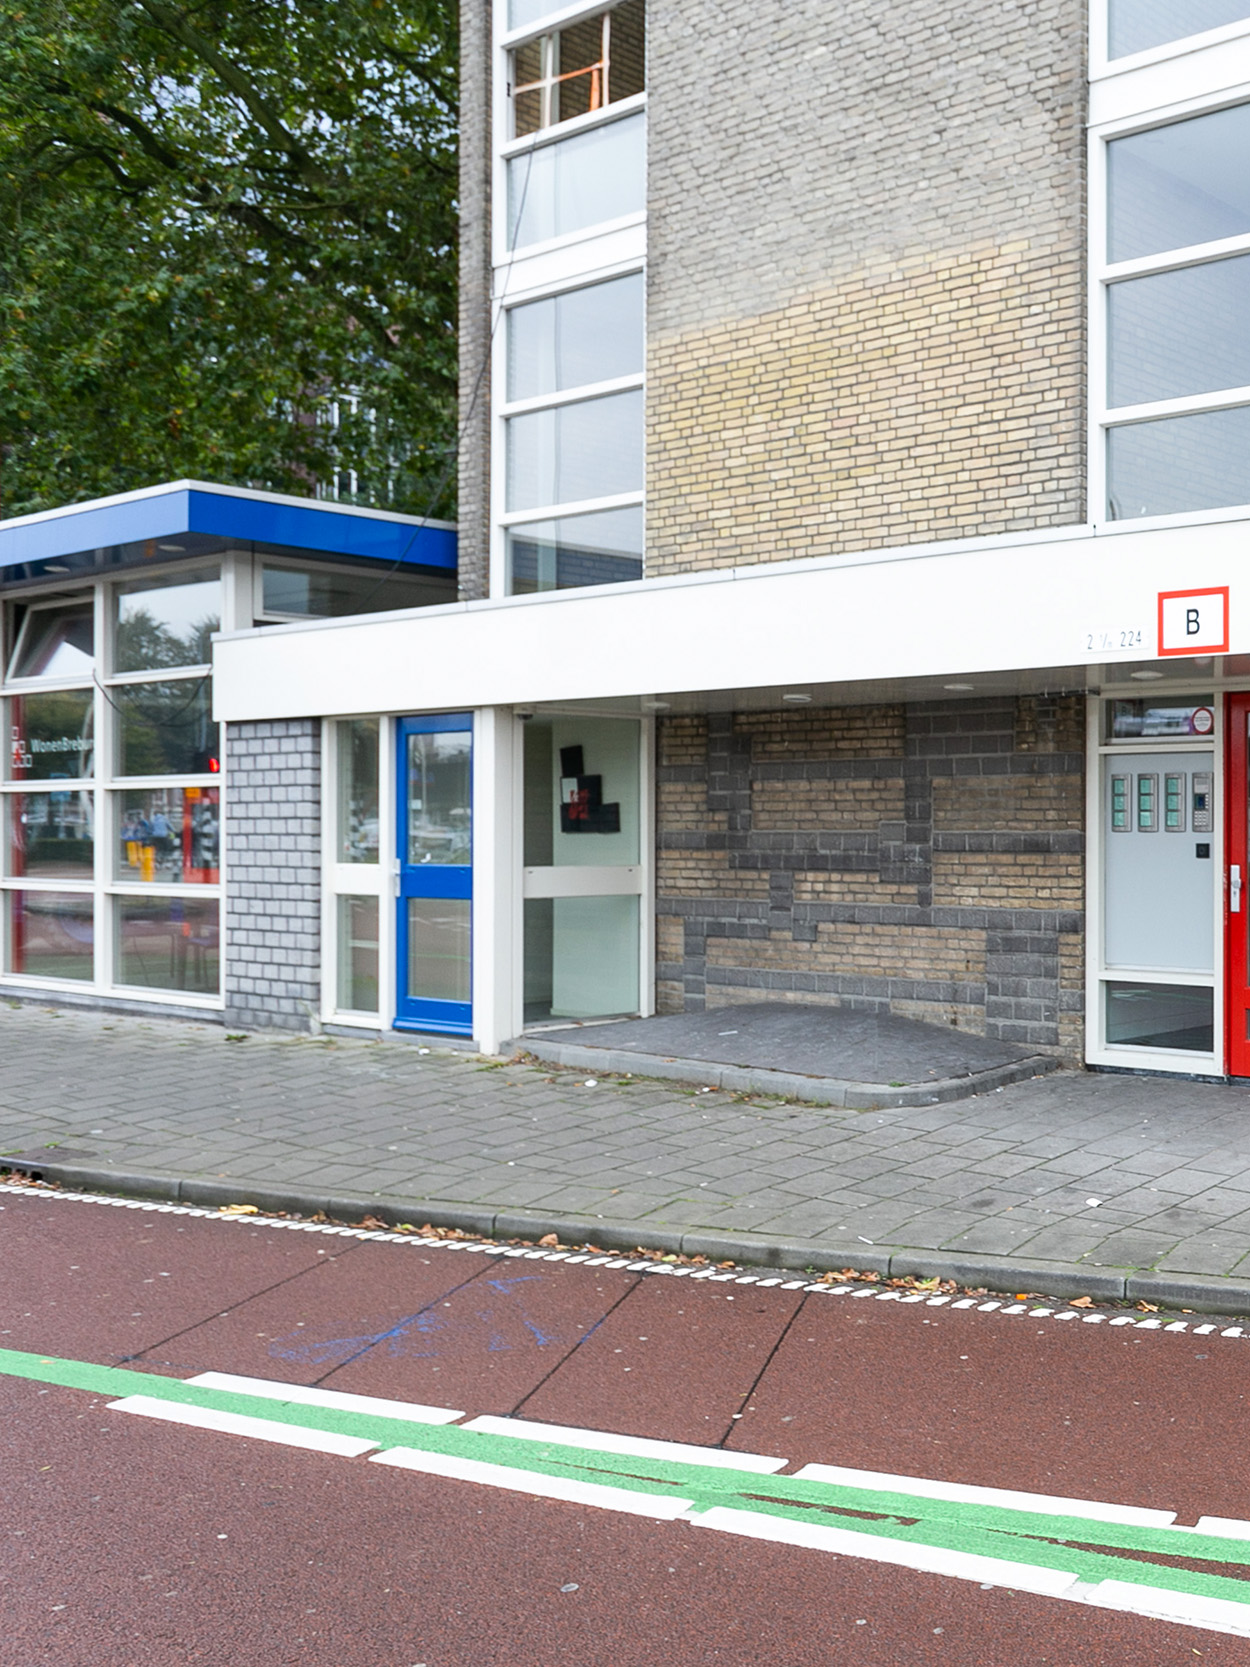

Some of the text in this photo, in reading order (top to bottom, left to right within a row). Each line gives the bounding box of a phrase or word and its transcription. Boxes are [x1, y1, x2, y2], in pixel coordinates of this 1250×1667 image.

[1186, 608, 1200, 636] B
[1087, 634, 1094, 650] 2
[1120, 630, 1142, 647] 224
